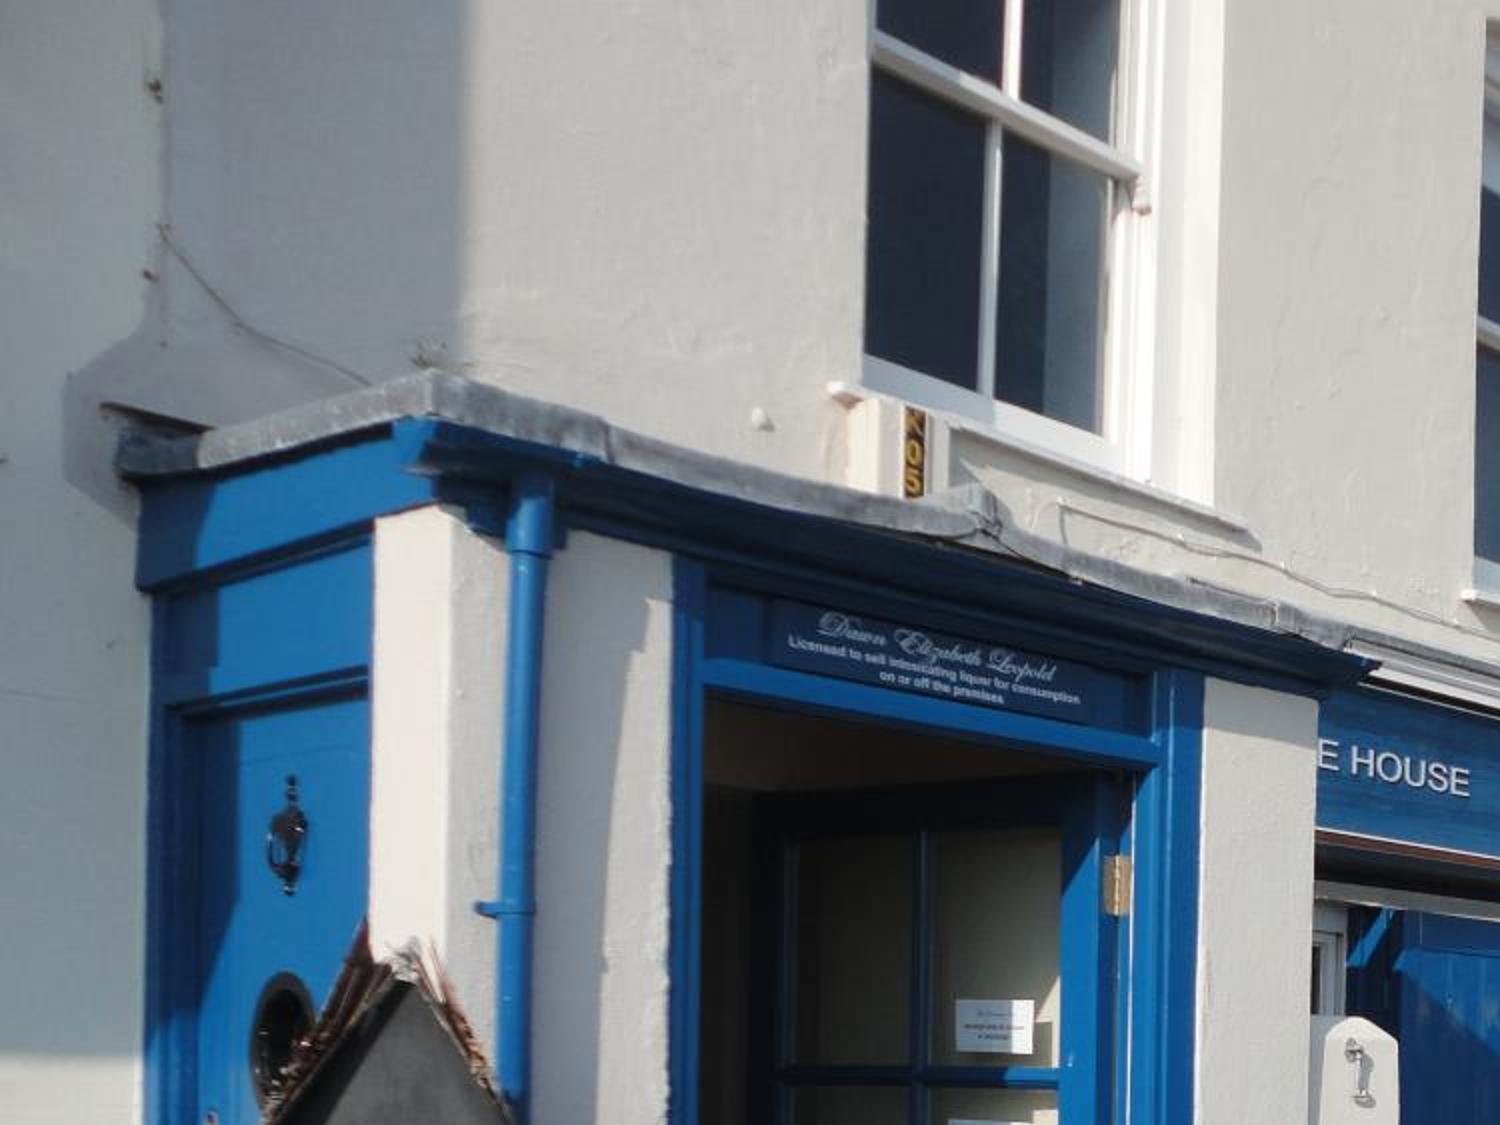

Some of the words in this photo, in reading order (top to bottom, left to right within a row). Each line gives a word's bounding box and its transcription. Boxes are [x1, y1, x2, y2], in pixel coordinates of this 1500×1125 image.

[788, 634, 847, 656] Licensed
[848, 648, 862, 660] to
[864, 652, 886, 665] sell
[959, 671, 992, 686] liquor
[993, 677, 1010, 690] for
[1011, 682, 1081, 704] consumption
[894, 629, 982, 666] Elizabeth
[879, 671, 897, 683] on
[898, 675, 910, 685] or
[912, 677, 930, 689] off
[931, 680, 952, 693] the
[953, 686, 1005, 704] premises
[1351, 744, 1471, 797] HOUSE
